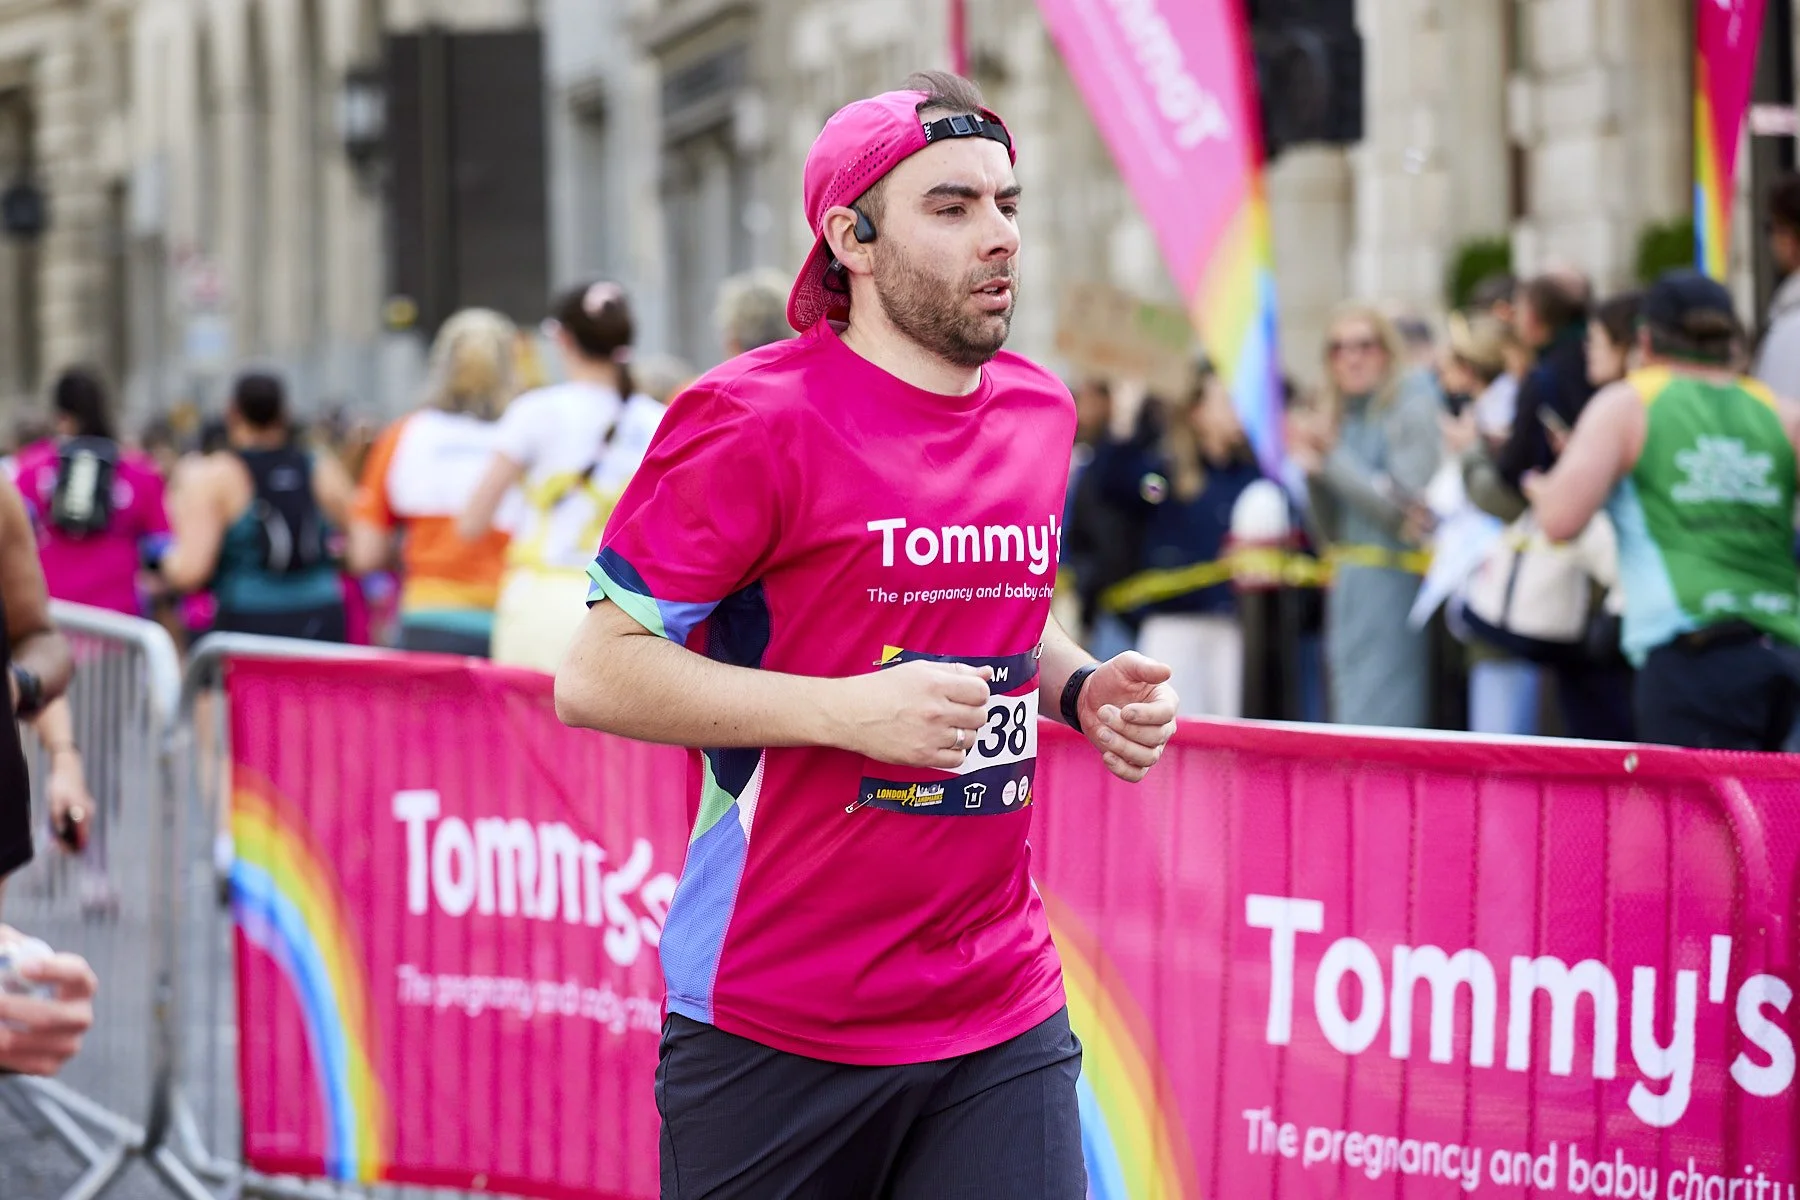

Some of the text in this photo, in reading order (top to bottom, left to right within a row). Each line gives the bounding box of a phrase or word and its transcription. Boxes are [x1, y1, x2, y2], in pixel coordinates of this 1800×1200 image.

[867, 587, 898, 603] The
[903, 585, 973, 605] pregnancy
[976, 583, 1001, 599] and
[1005, 582, 1038, 601] baby
[966, 701, 1027, 758] 38
[876, 788, 908, 799] LONDON
[1245, 894, 1797, 1127] Tommy's
[1242, 1105, 1298, 1158] The
[1303, 1126, 1482, 1192] pregnancy
[1489, 1141, 1557, 1191] and
[1568, 1142, 1659, 1200] baby
